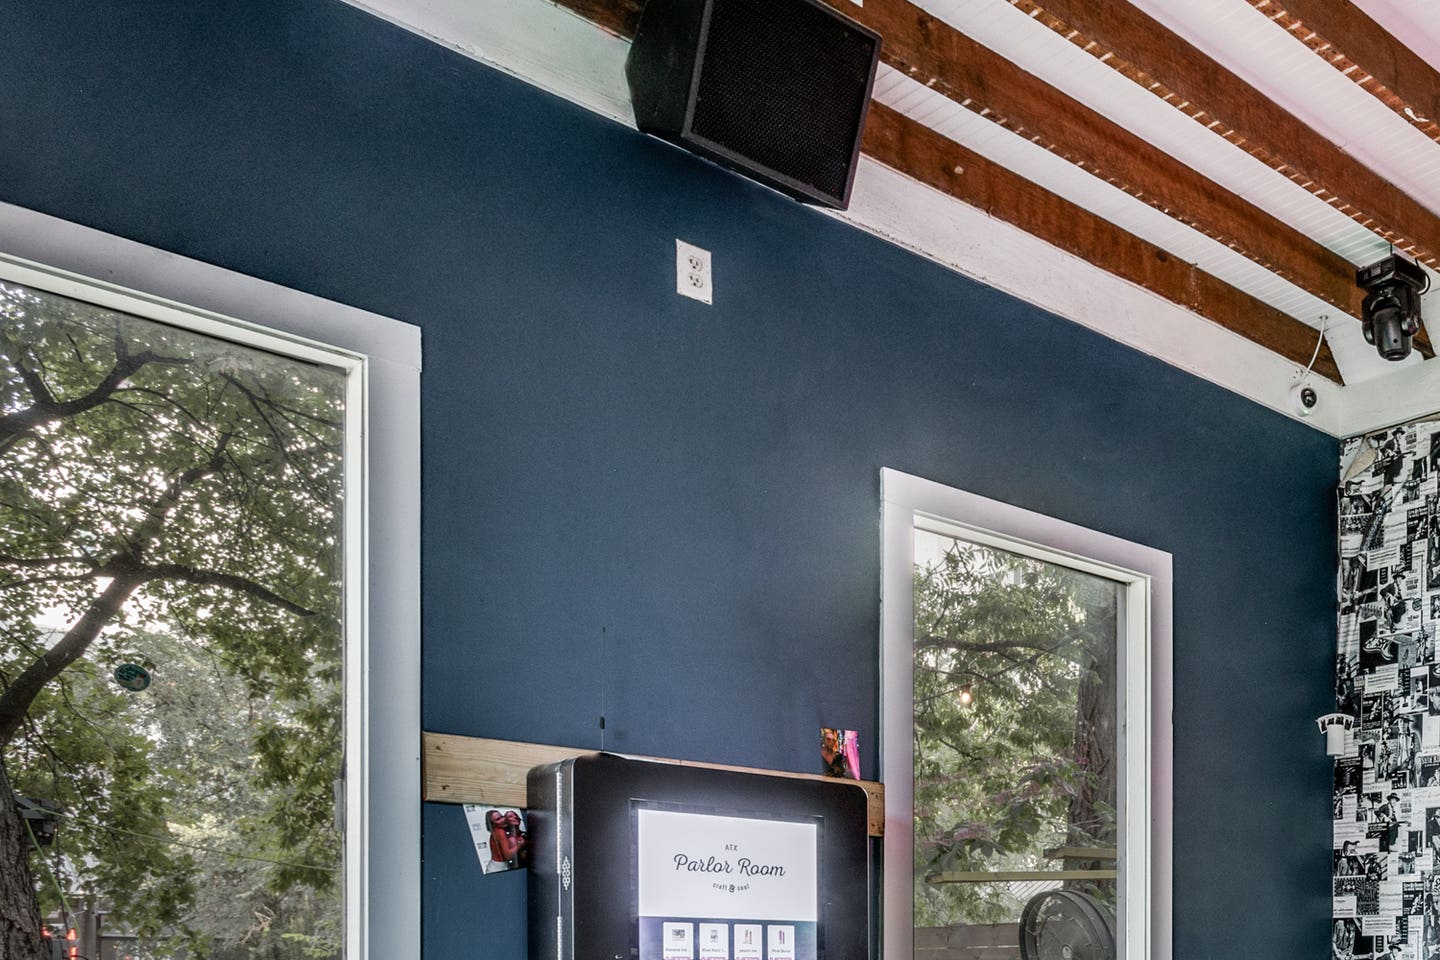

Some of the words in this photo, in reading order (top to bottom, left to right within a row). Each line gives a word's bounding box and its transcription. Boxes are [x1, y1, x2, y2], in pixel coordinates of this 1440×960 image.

[724, 843, 738, 852] ATX
[673, 853, 734, 874] Parlor
[736, 857, 787, 878] Room
